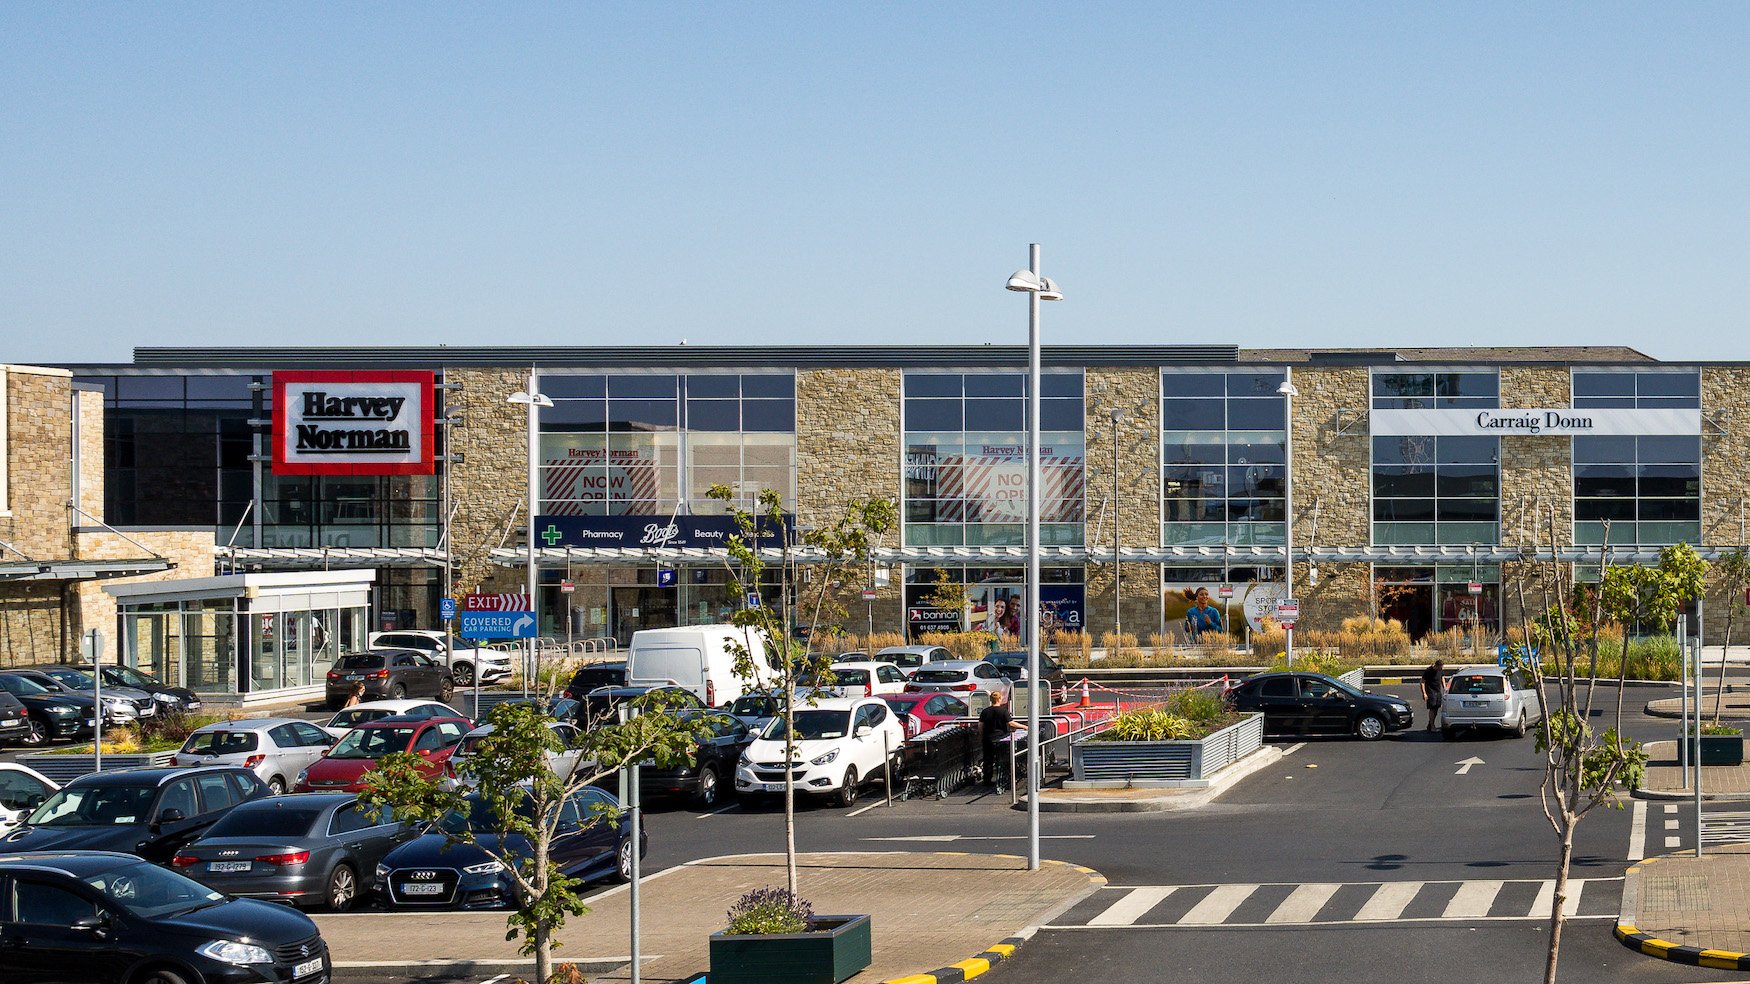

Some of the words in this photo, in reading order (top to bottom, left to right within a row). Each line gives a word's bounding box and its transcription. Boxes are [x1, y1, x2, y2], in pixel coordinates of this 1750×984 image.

[302, 391, 406, 422] Harvey
[1477, 411, 1541, 434] Carraig
[1544, 411, 1594, 428] Donn
[295, 424, 411, 450] Norman
[568, 448, 601, 458] Harvey
[982, 445, 1015, 456] Harvey
[583, 476, 625, 489] NOW
[997, 473, 1030, 486] NO
[582, 529, 624, 540] Pharmacy
[640, 523, 680, 544] Boots
[694, 529, 724, 539] Beauty
[468, 596, 500, 609] EXIT
[923, 610, 959, 620] bannon
[463, 617, 512, 627] COVERED
